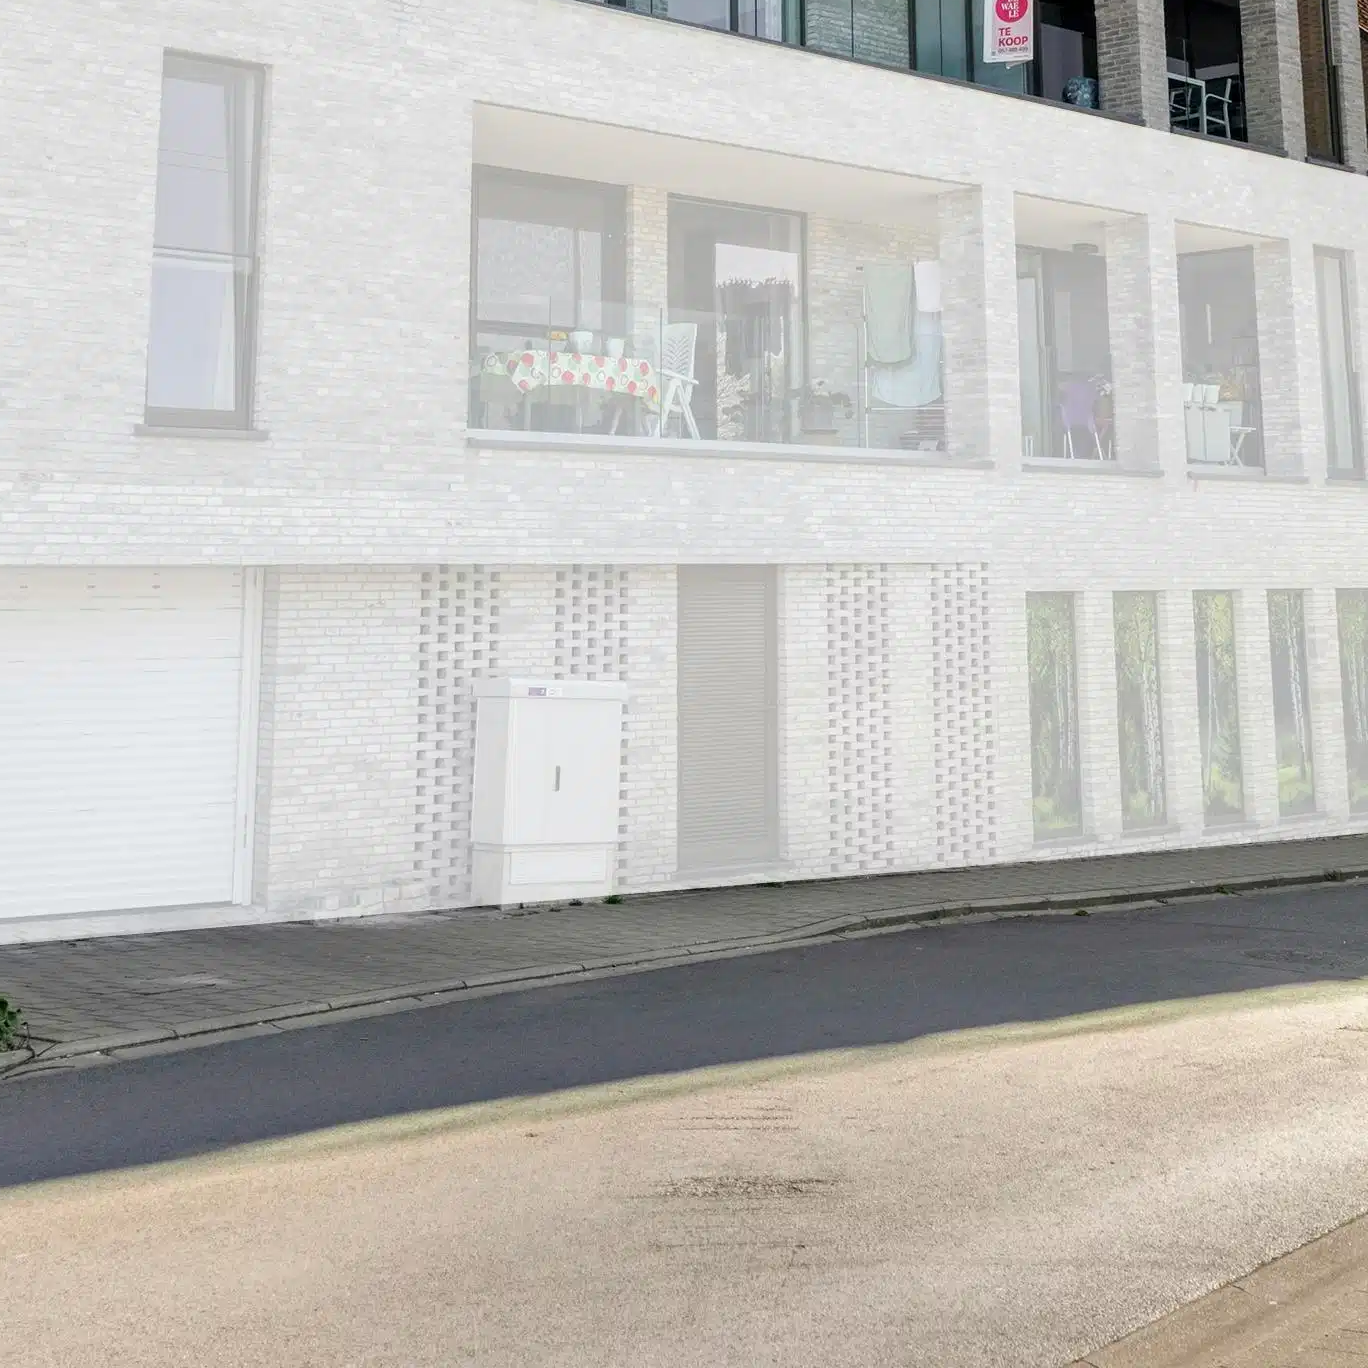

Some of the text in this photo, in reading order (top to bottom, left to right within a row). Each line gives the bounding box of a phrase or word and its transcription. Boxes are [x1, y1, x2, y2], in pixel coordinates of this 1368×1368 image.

[1001, 2, 1019, 10] WAE
[1008, 10, 1019, 18] LE
[998, 27, 1012, 36] TE
[998, 36, 1028, 47] KOOP
